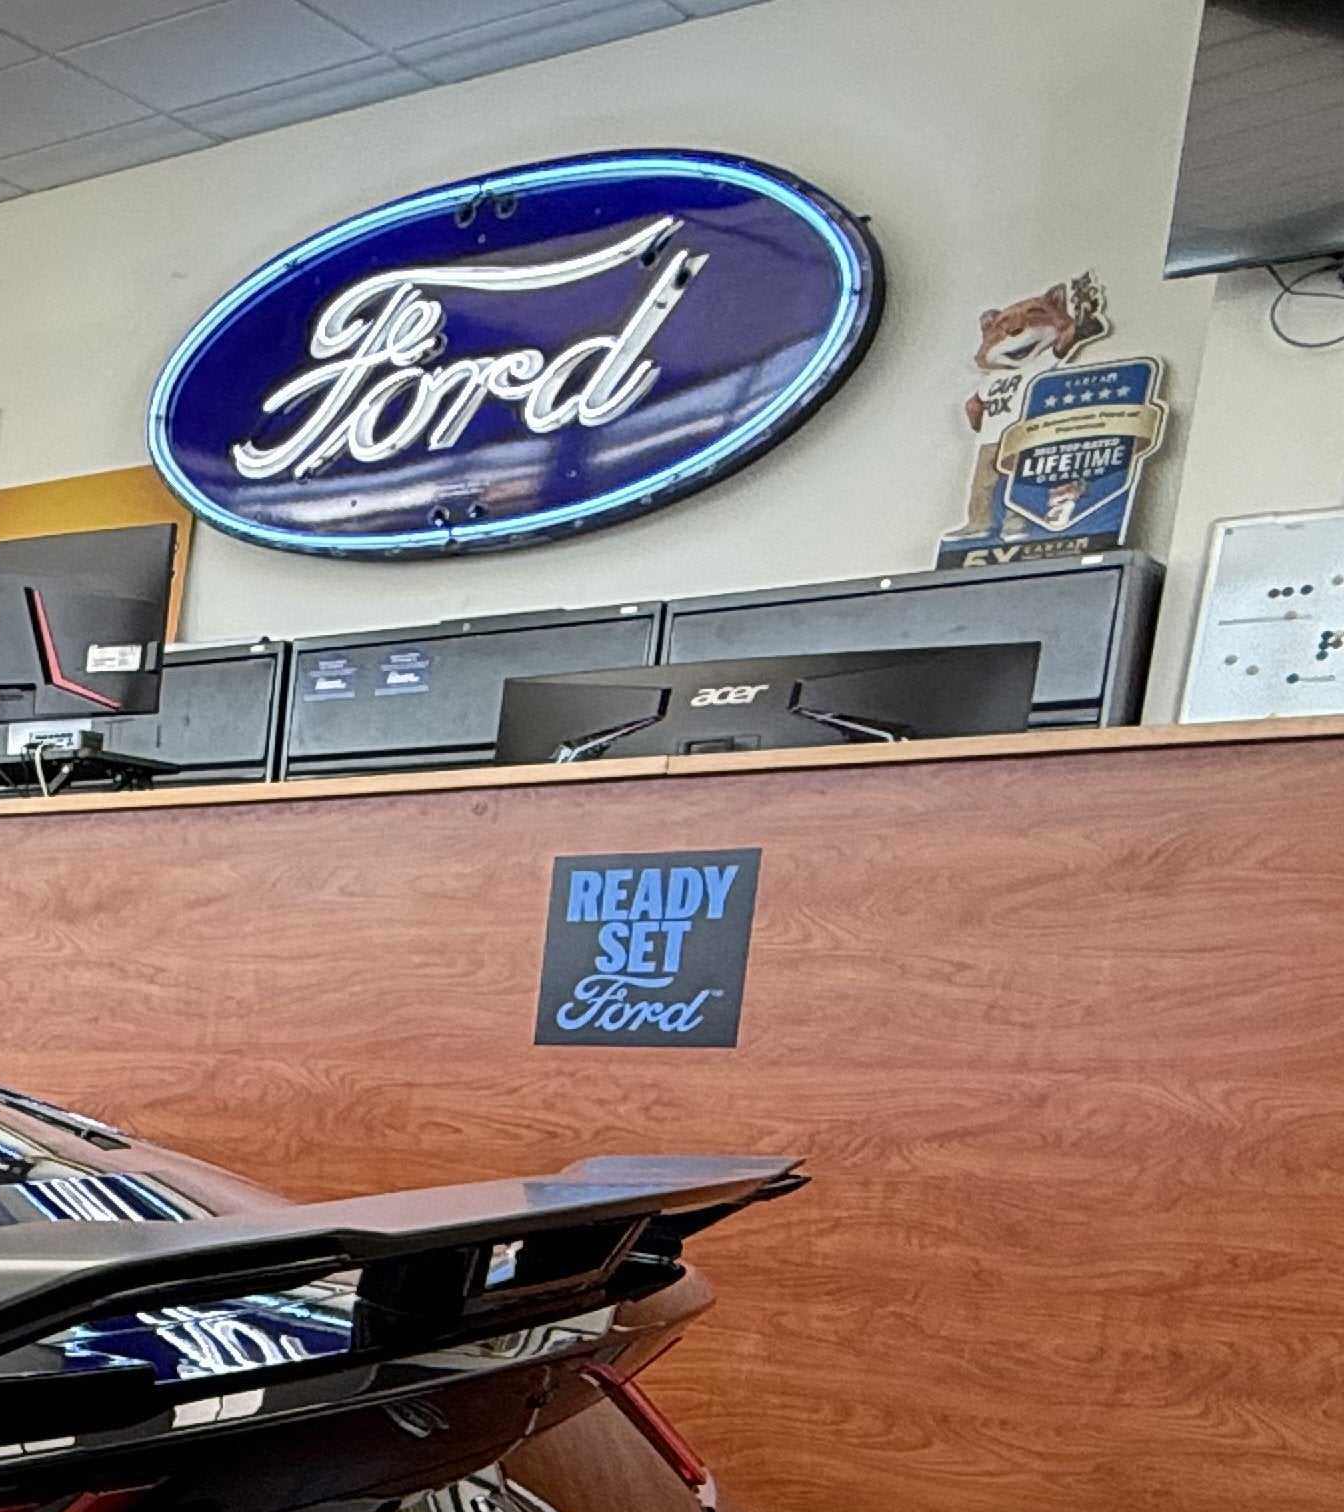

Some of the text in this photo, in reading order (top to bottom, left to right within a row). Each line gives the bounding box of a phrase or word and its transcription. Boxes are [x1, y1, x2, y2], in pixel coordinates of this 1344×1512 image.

[232, 214, 710, 482] Ford
[1022, 445, 1127, 478] LIFETIME
[690, 684, 770, 707] acer
[566, 865, 739, 923] READY
[594, 920, 693, 974] SET
[556, 974, 710, 1033] Ford
